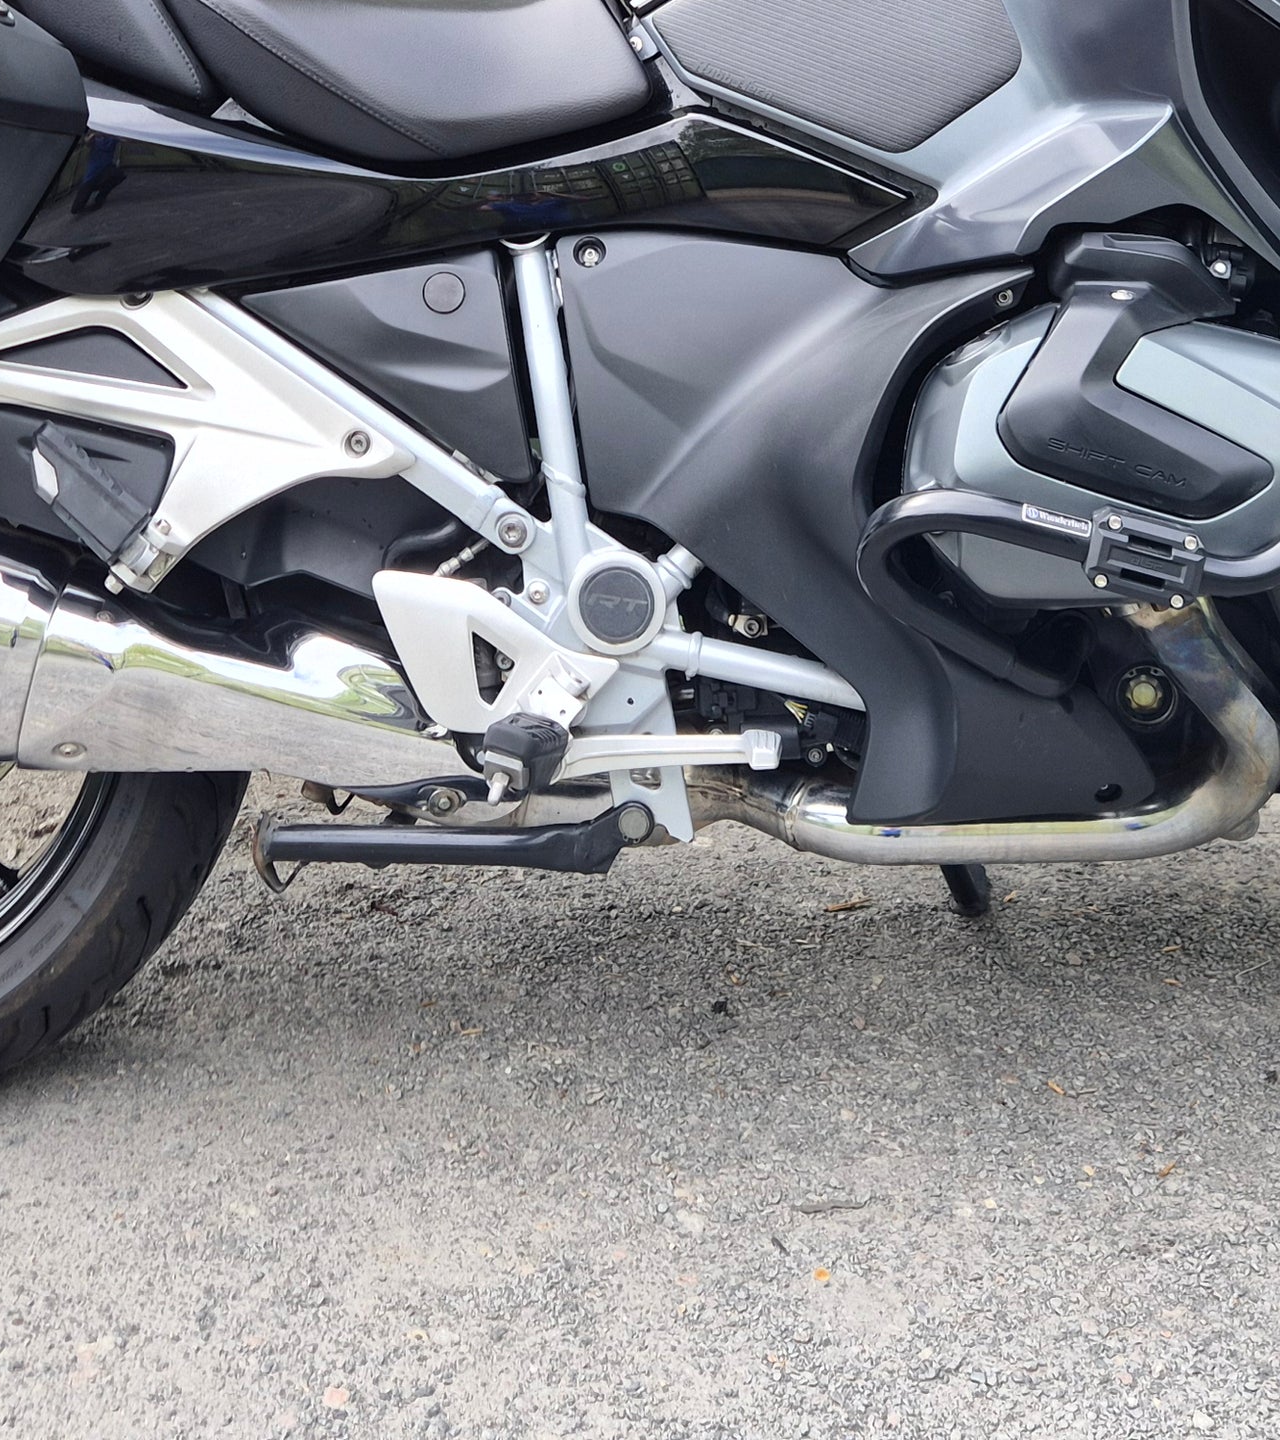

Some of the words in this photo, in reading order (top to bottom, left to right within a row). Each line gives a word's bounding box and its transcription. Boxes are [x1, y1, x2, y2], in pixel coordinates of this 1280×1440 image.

[1047, 436, 1126, 468] SHIFT
[1134, 464, 1188, 488] CAM
[587, 592, 648, 613] RT
